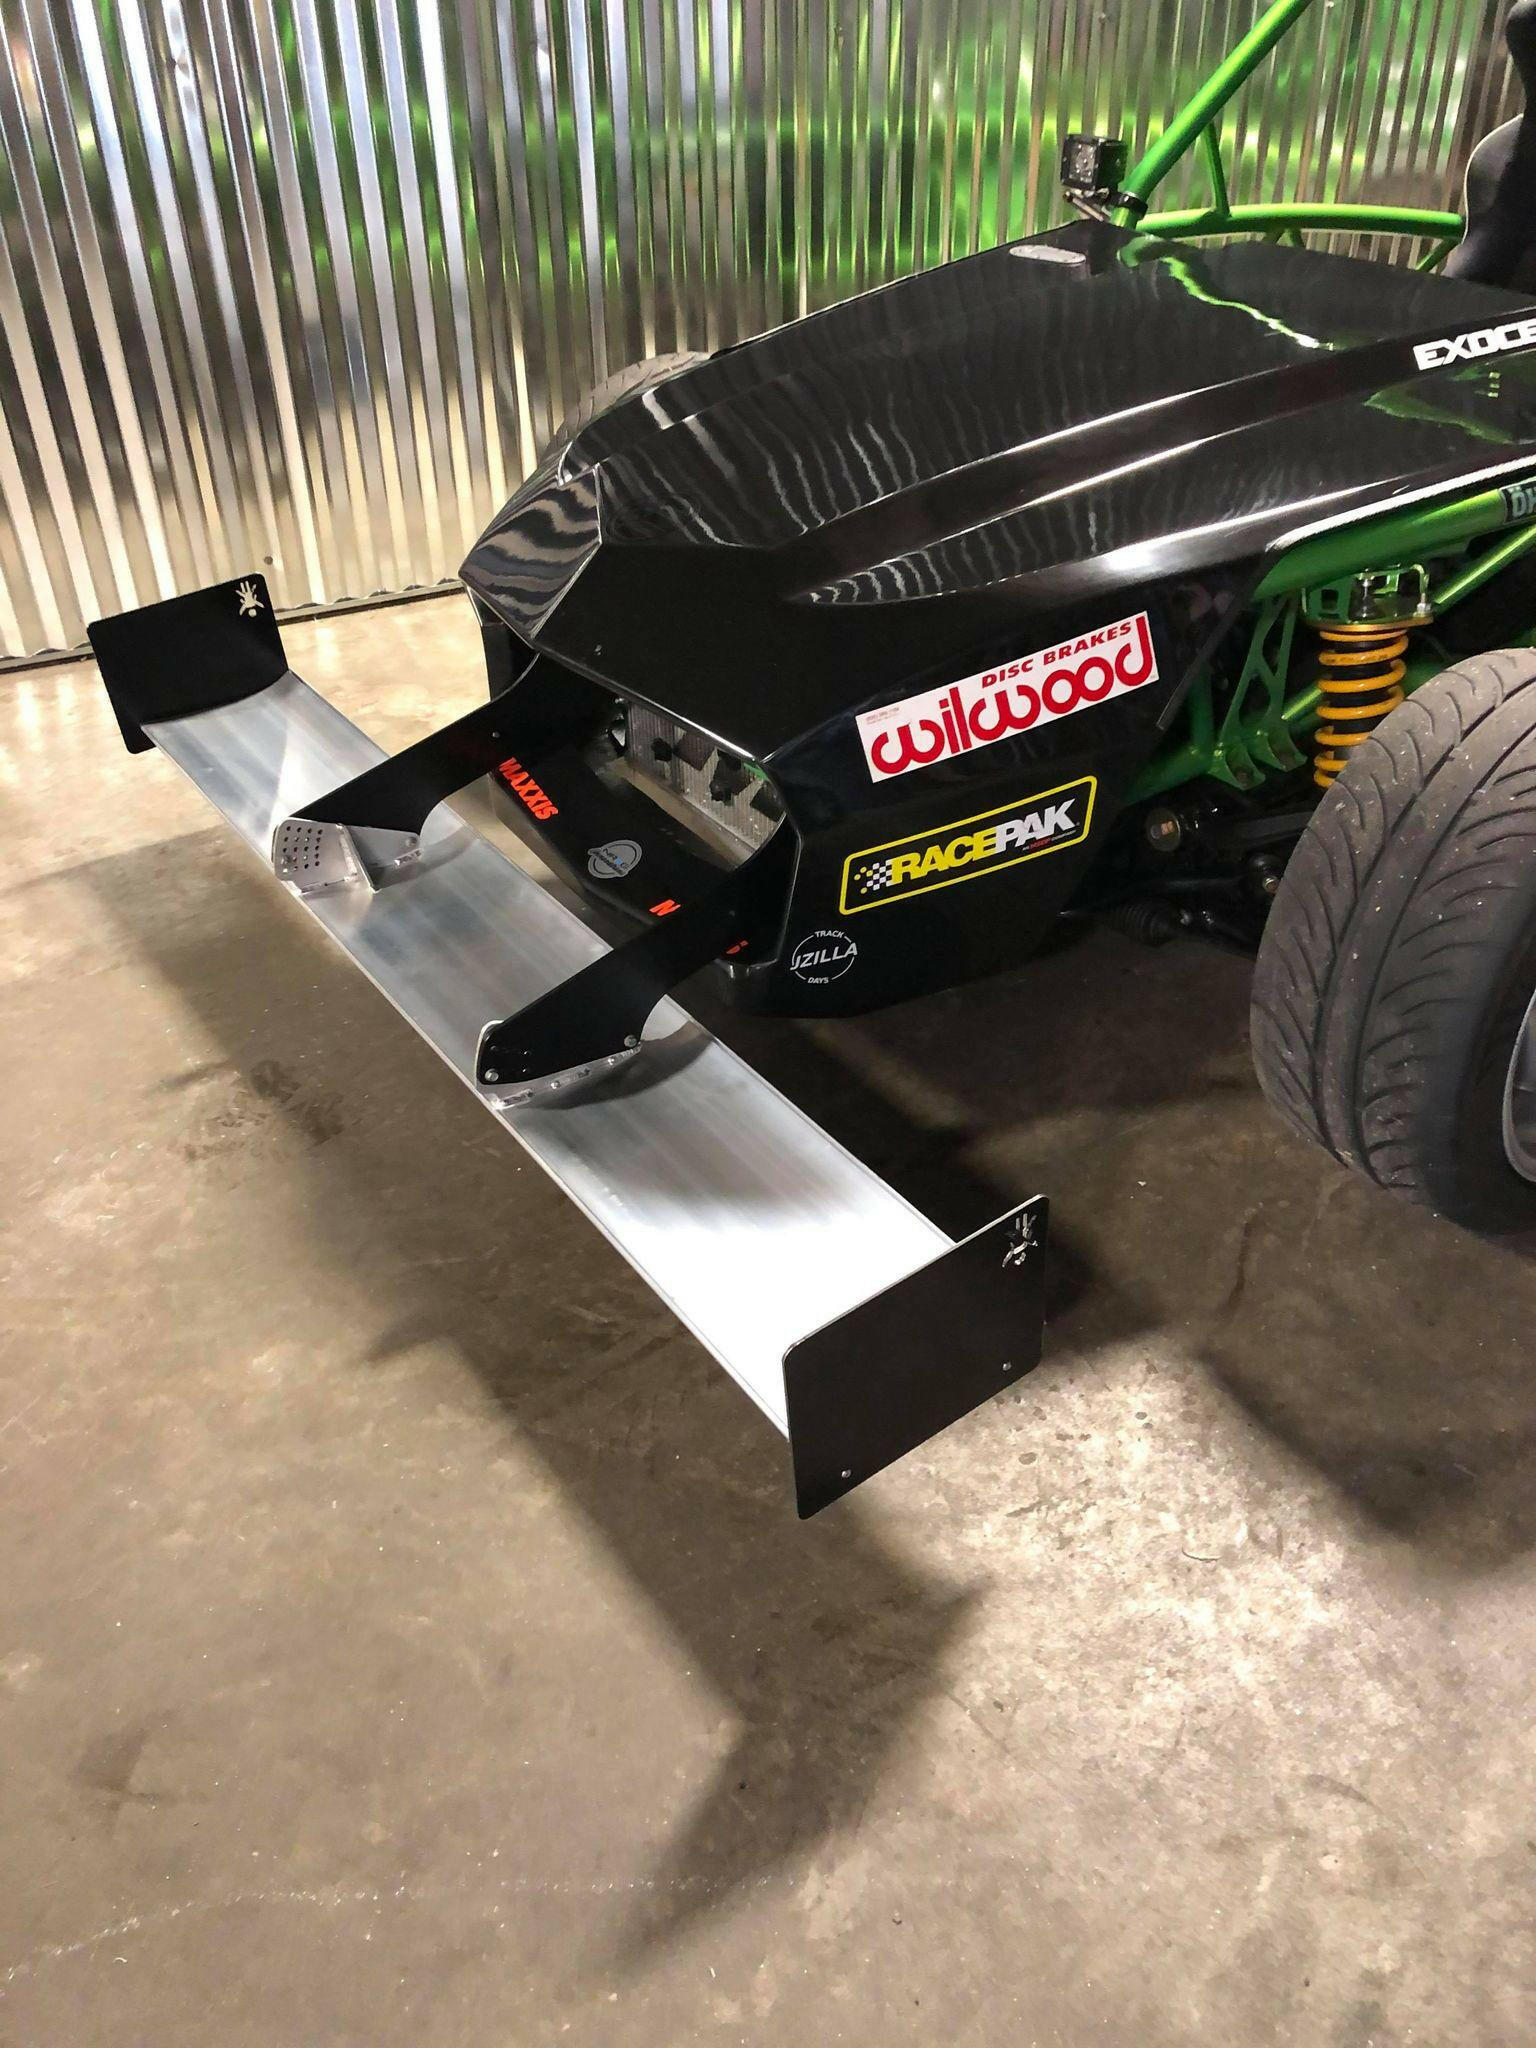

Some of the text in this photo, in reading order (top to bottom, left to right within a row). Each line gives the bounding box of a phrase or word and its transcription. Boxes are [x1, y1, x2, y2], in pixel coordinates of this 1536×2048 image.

[981, 620, 1132, 689] DISC BRAKES
[870, 614, 1154, 775] wilwood
[499, 756, 559, 820] MAXXIS
[890, 798, 1076, 886] RACEPAK
[789, 942, 858, 971] JZILLA
[814, 930, 845, 939] TRACK
[807, 976, 830, 985] DAYS
